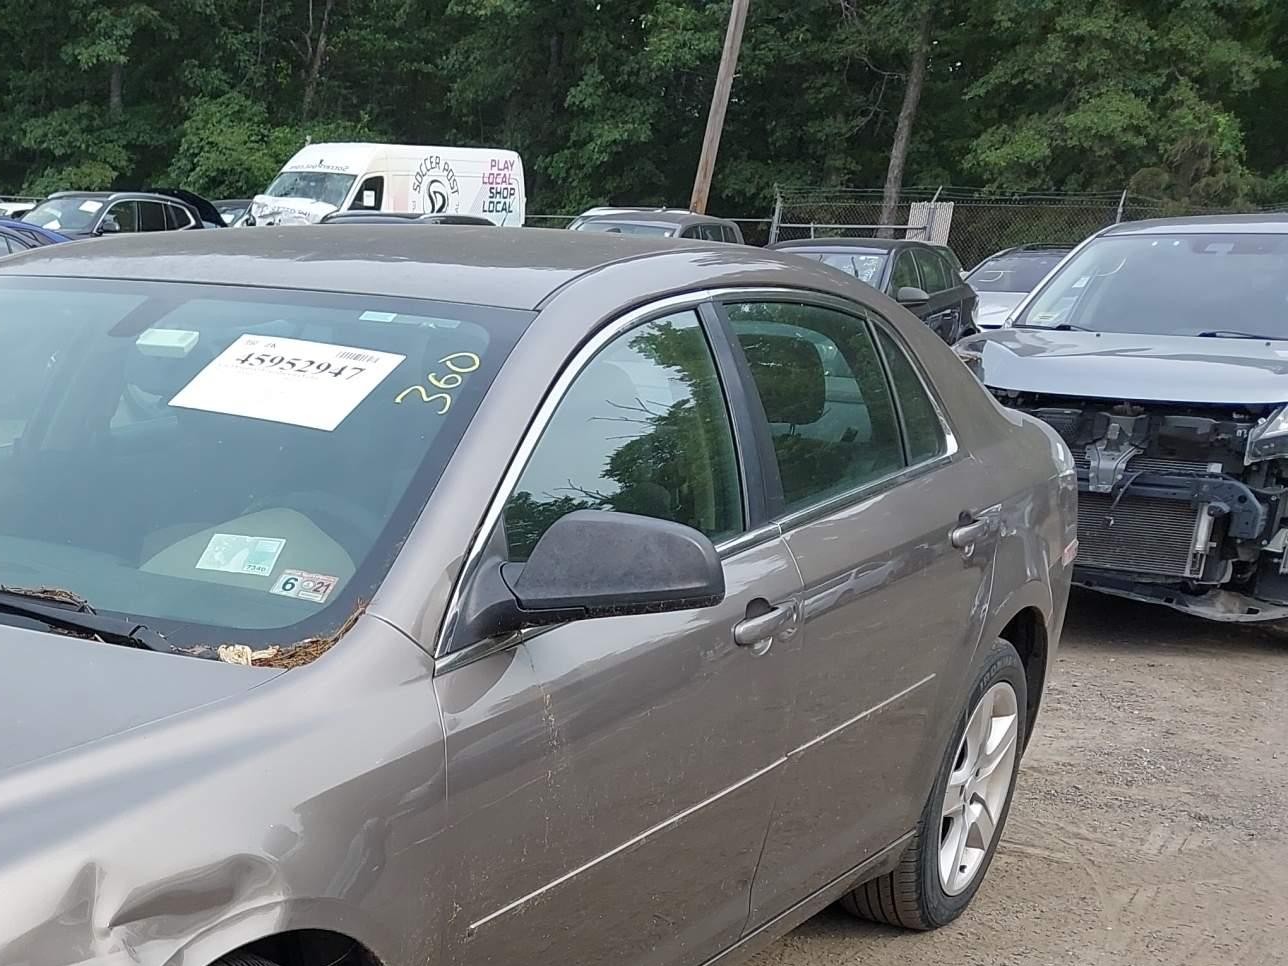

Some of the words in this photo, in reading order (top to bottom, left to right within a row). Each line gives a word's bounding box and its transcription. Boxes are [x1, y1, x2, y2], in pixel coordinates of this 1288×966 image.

[490, 159, 515, 171] PLAY
[413, 155, 441, 194] SOCCER
[442, 161, 459, 195] POST
[482, 172, 513, 185] LOCAL
[489, 186, 515, 199] SHOP
[482, 200, 513, 213] LOCAL
[235, 352, 367, 380] 45952947
[394, 351, 481, 415] 360
[281, 576, 298, 592] 6
[312, 581, 332, 595] 21
